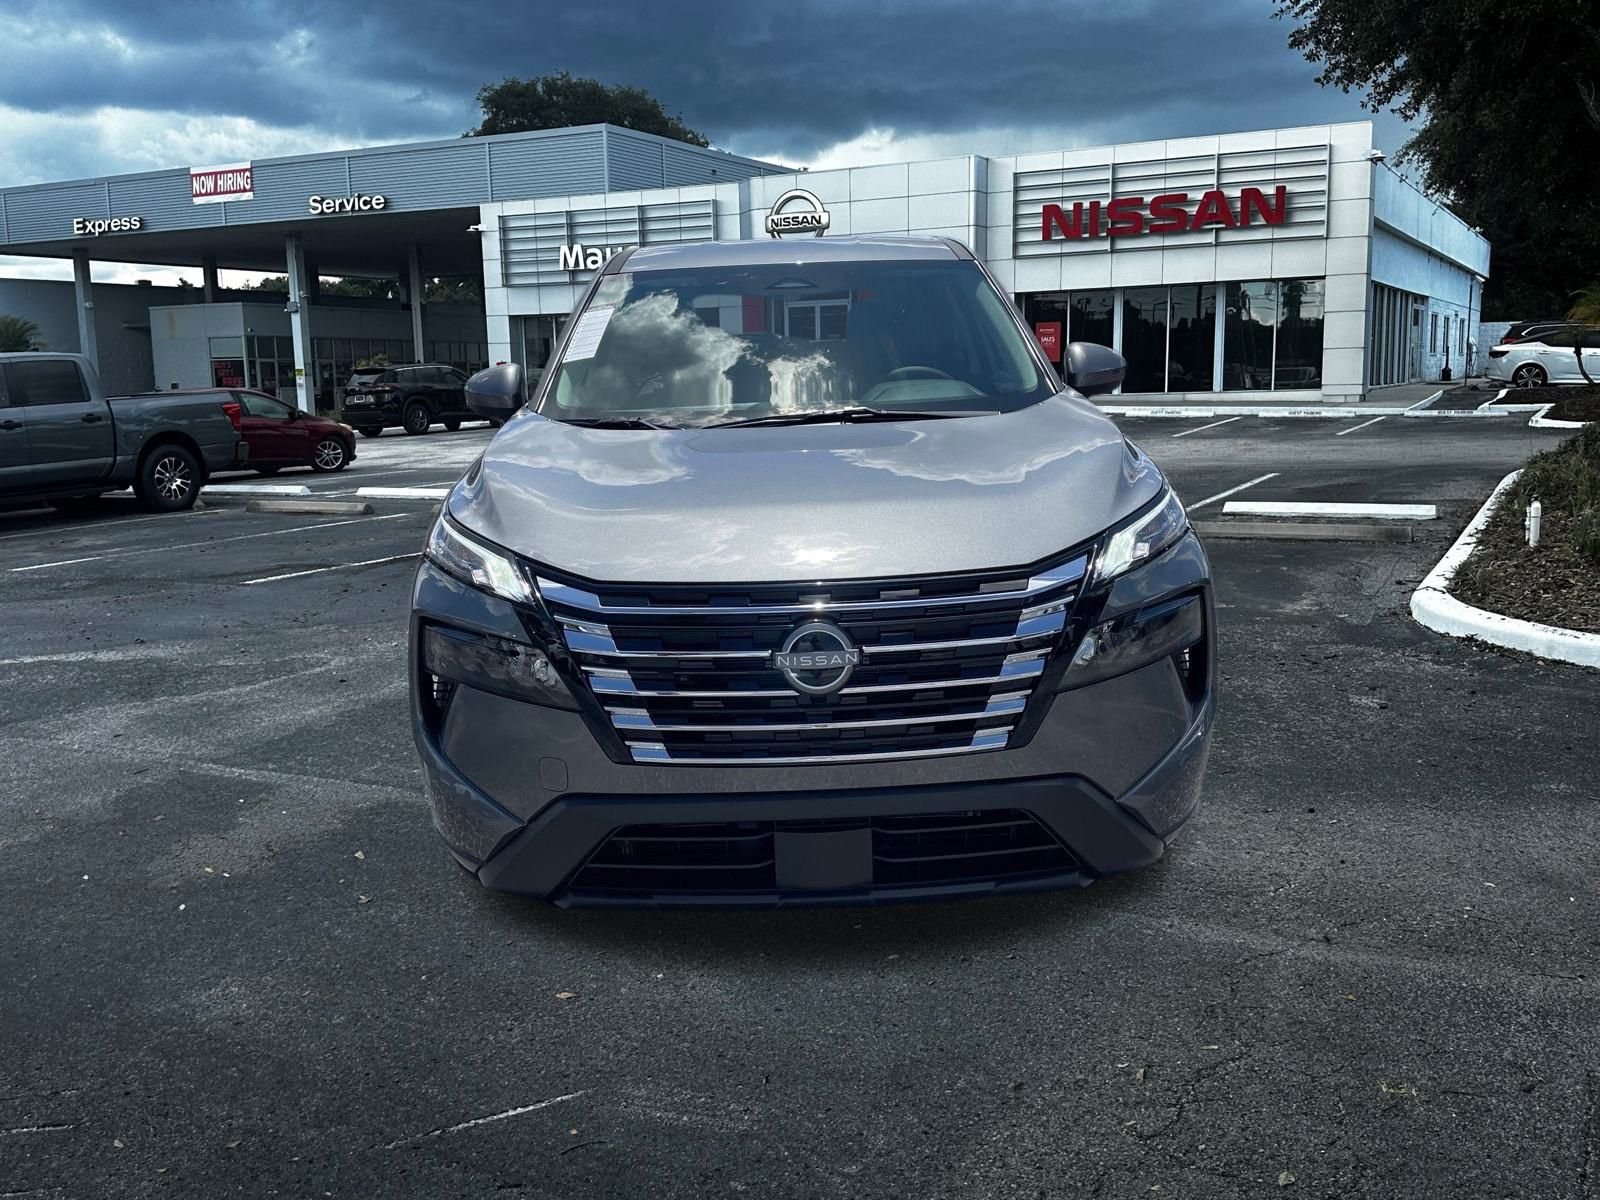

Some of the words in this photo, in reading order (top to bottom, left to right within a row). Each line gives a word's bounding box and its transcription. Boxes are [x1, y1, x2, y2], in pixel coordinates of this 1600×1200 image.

[192, 175, 216, 195] NOW
[217, 171, 251, 192] HIRING
[308, 192, 385, 215] Service
[1041, 185, 1287, 241] NISSAN
[73, 216, 141, 237] Express
[770, 214, 822, 229] NISSAN
[777, 652, 858, 666] NISSAN
